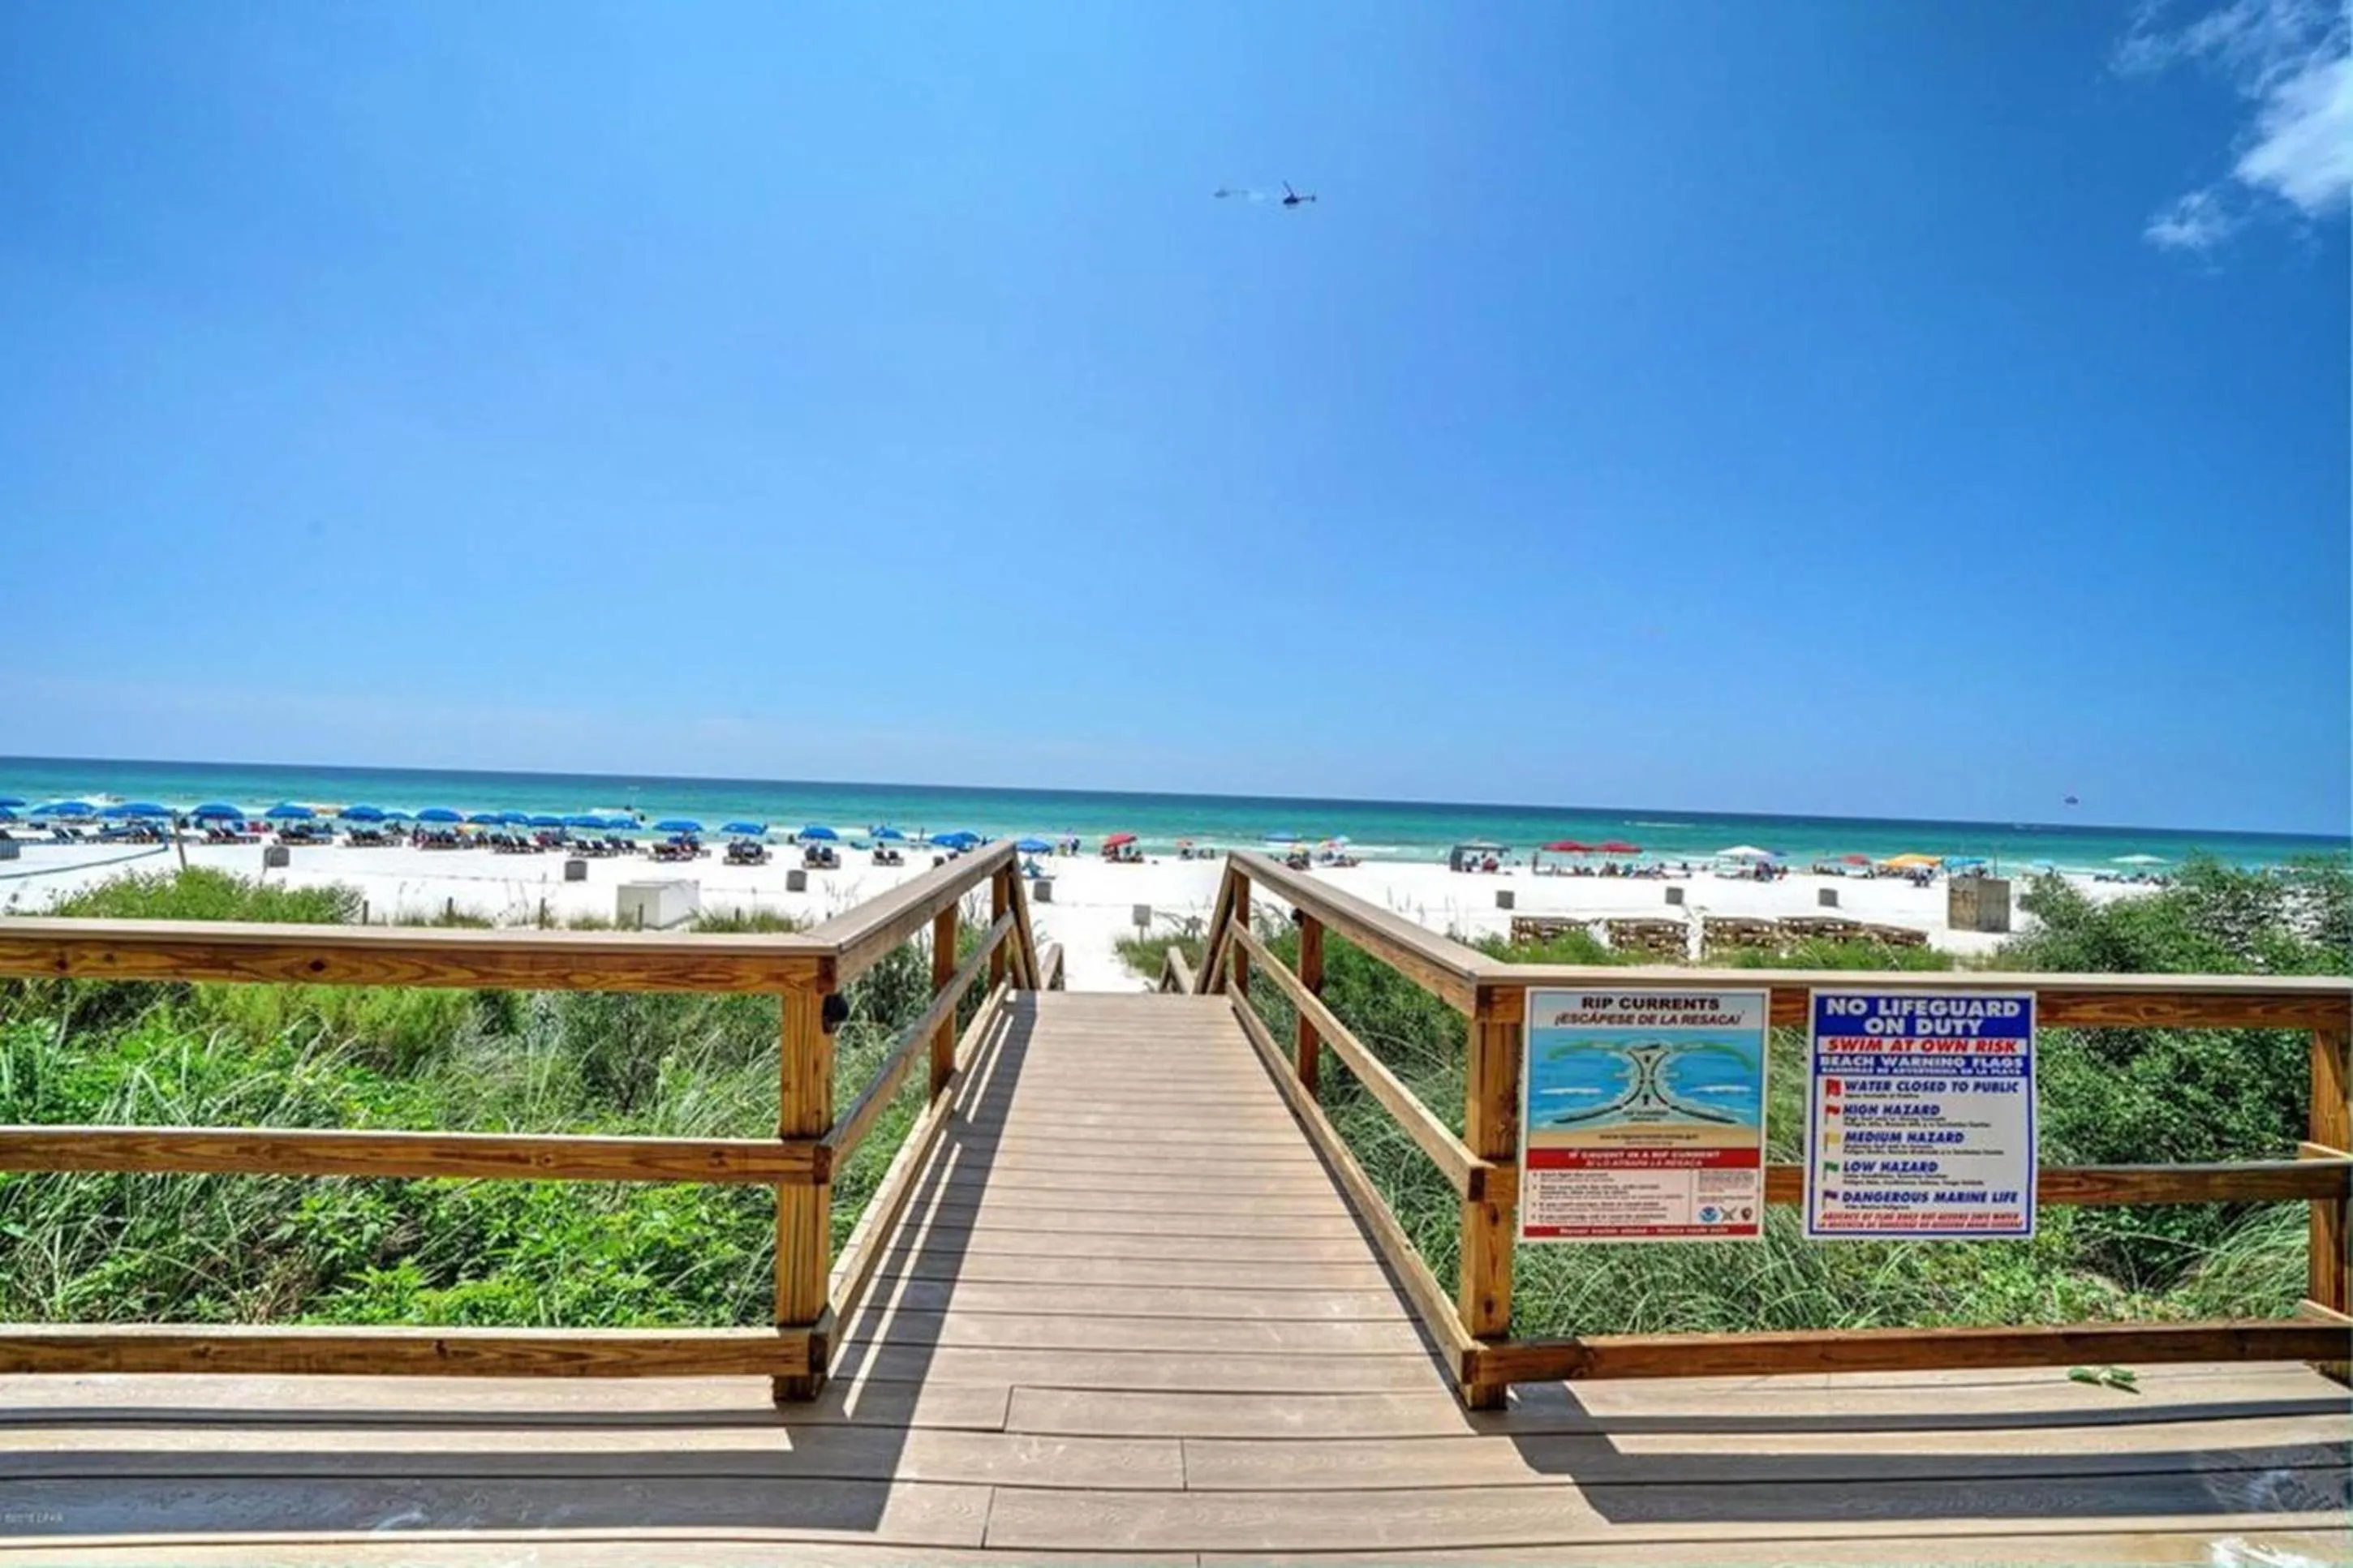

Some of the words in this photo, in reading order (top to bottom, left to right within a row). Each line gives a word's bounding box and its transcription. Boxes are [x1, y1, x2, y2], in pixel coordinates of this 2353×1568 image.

[1581, 997, 1614, 1009] RIP
[1619, 998, 1719, 1010] CURRENTS
[1826, 999, 1868, 1016] NO
[1877, 999, 2020, 1017] LIFEGUARD
[1637, 1014, 1656, 1025] DE
[1659, 1014, 1678, 1025] LA
[1865, 1018, 1905, 1035] ON
[1916, 1019, 1984, 1036] DUTY
[1827, 1039, 1882, 1052] SWIM
[1889, 1039, 1913, 1052] AT
[1921, 1040, 1968, 1052] OWN
[1975, 1040, 2018, 1053] RISK
[1820, 1056, 1874, 1067] BEACH
[1881, 1057, 1965, 1068] WARNING
[1972, 1057, 2023, 1068] FLAGS
[1844, 1080, 1891, 1092] WATER
[1896, 1081, 1946, 1093] CLOSED
[1951, 1081, 1969, 1093] TO
[1973, 1081, 2020, 1093] PUBLIC
[1843, 1104, 1878, 1115] HIGH
[1882, 1105, 1940, 1115] HAZARD
[1843, 1132, 1902, 1143] MEDIUM
[1907, 1132, 1964, 1143] HAZARD
[1843, 1161, 1875, 1172] LOW
[1880, 1162, 1938, 1172] HAZARD
[1842, 1191, 1929, 1203] DANGEROUS
[1934, 1191, 1988, 1203] MARINE
[1992, 1192, 2019, 1203] LIFE
